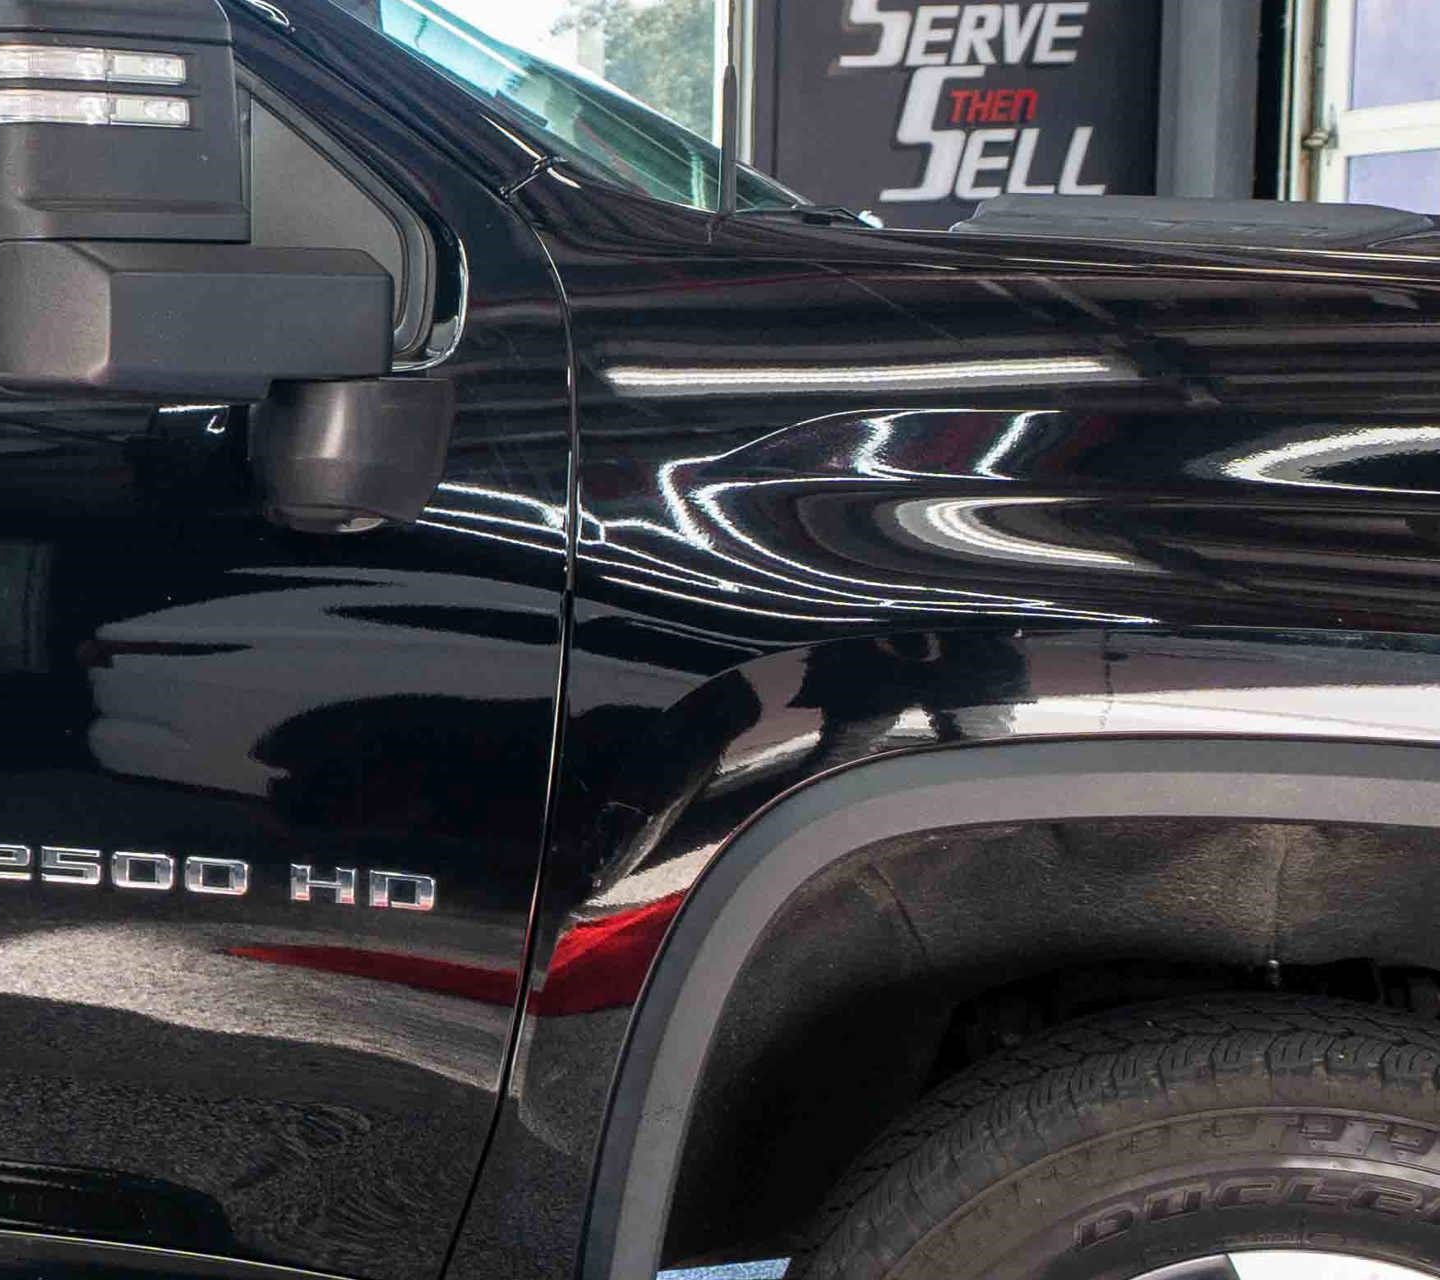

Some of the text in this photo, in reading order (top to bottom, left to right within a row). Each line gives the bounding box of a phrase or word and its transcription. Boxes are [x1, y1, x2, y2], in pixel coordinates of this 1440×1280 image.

[948, 87, 1040, 124] THEN
[878, 64, 1107, 203] SELL
[289, 862, 438, 913] HD
